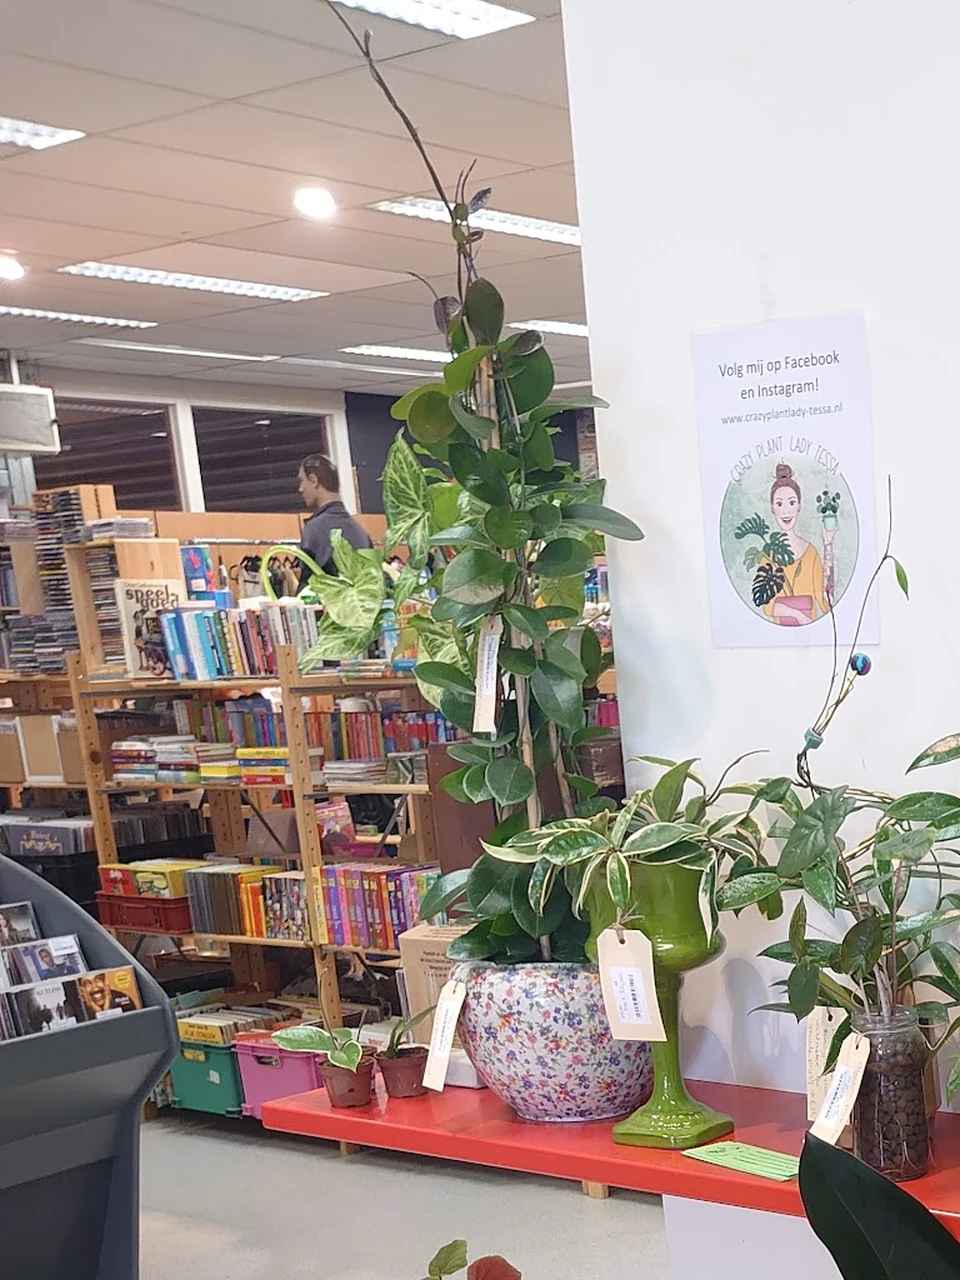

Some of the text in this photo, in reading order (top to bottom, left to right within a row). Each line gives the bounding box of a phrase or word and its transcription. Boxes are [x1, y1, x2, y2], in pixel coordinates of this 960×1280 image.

[718, 350, 840, 379] Volg mij op Facebook
[740, 377, 819, 400] en Instagram!
[721, 402, 843, 425] www.crazyplantlady-tessa.nl
[730, 435, 840, 482] CRAZY PLANT LADY TESSA
